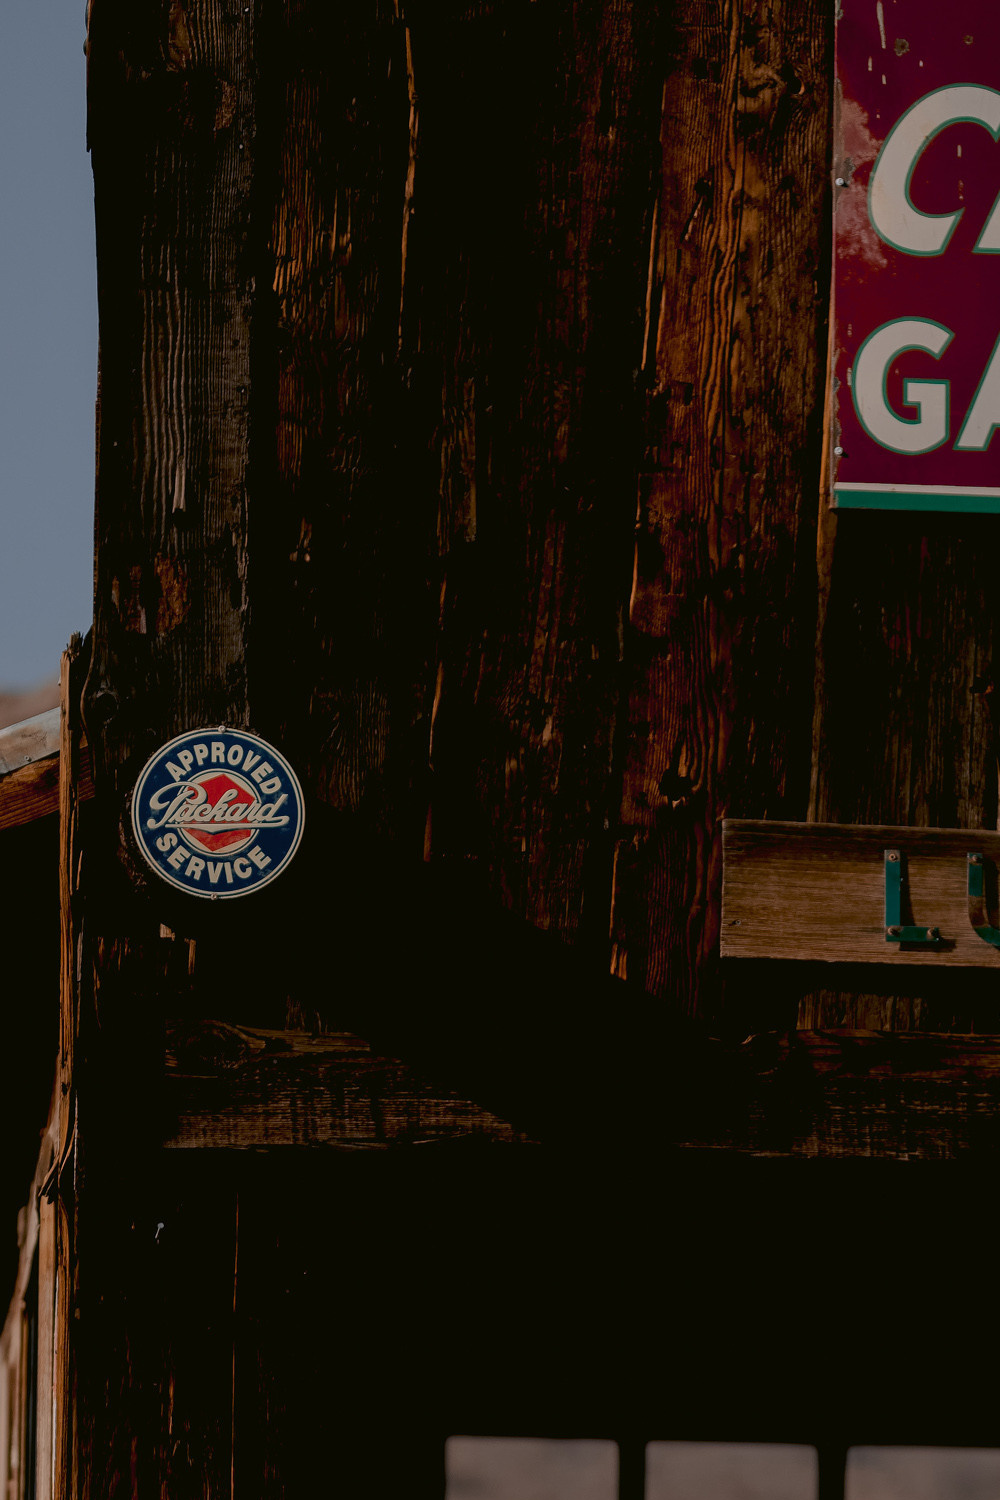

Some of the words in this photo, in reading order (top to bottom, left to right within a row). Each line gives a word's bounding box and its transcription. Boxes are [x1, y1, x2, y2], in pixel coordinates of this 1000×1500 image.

[165, 741, 283, 795] APPROVED
[147, 781, 290, 831] Packard
[156, 832, 272, 884] SERVICE
